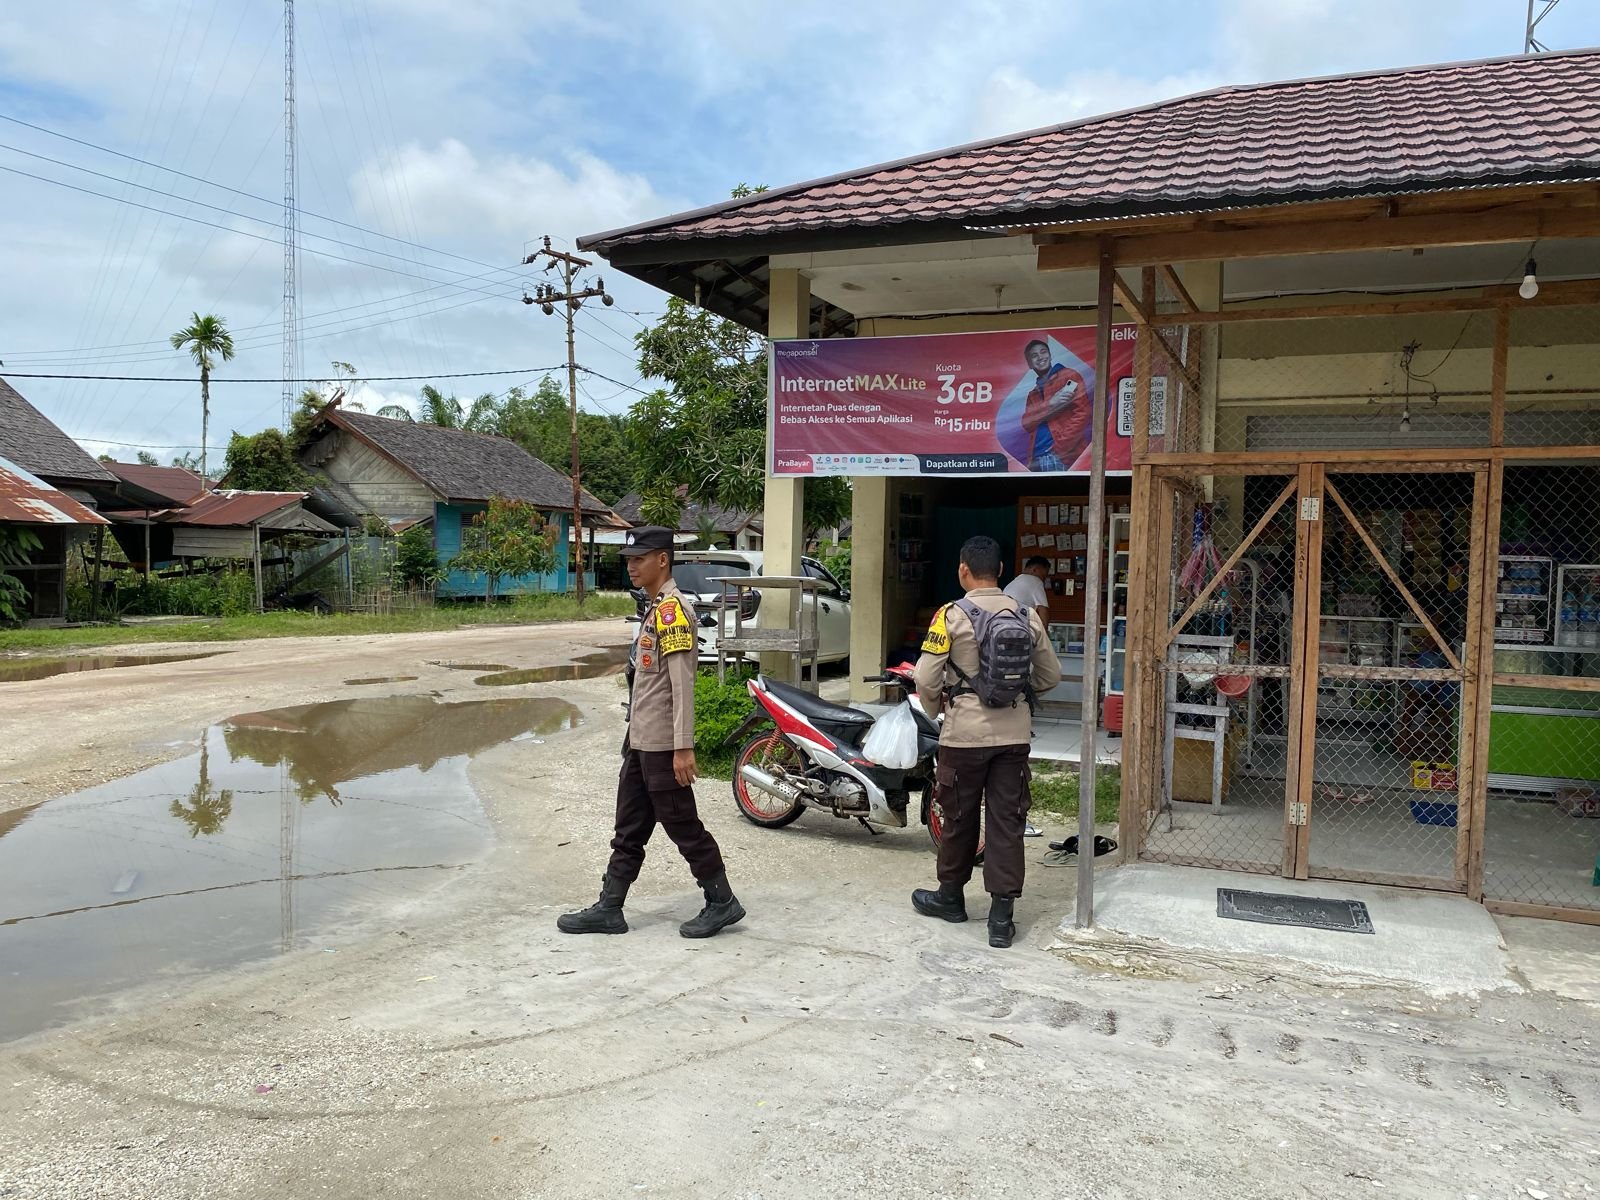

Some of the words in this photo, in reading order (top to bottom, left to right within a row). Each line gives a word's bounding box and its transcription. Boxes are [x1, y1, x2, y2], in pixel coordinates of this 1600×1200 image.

[935, 363, 961, 372] Kuota
[900, 377, 926, 390] Lite
[780, 403, 826, 412] Internetan
[827, 403, 847, 412] Puas
[848, 403, 881, 413] dengan
[780, 415, 807, 424] Bebas
[808, 415, 834, 424] Akses
[835, 415, 845, 423] ke
[846, 415, 876, 424] Semua
[877, 414, 913, 424] Aplikasi
[965, 420, 990, 430] ribu
[778, 459, 810, 467] PraBayar
[926, 460, 968, 469] Dapatkan
[969, 459, 978, 468] di
[979, 459, 995, 468] sini
